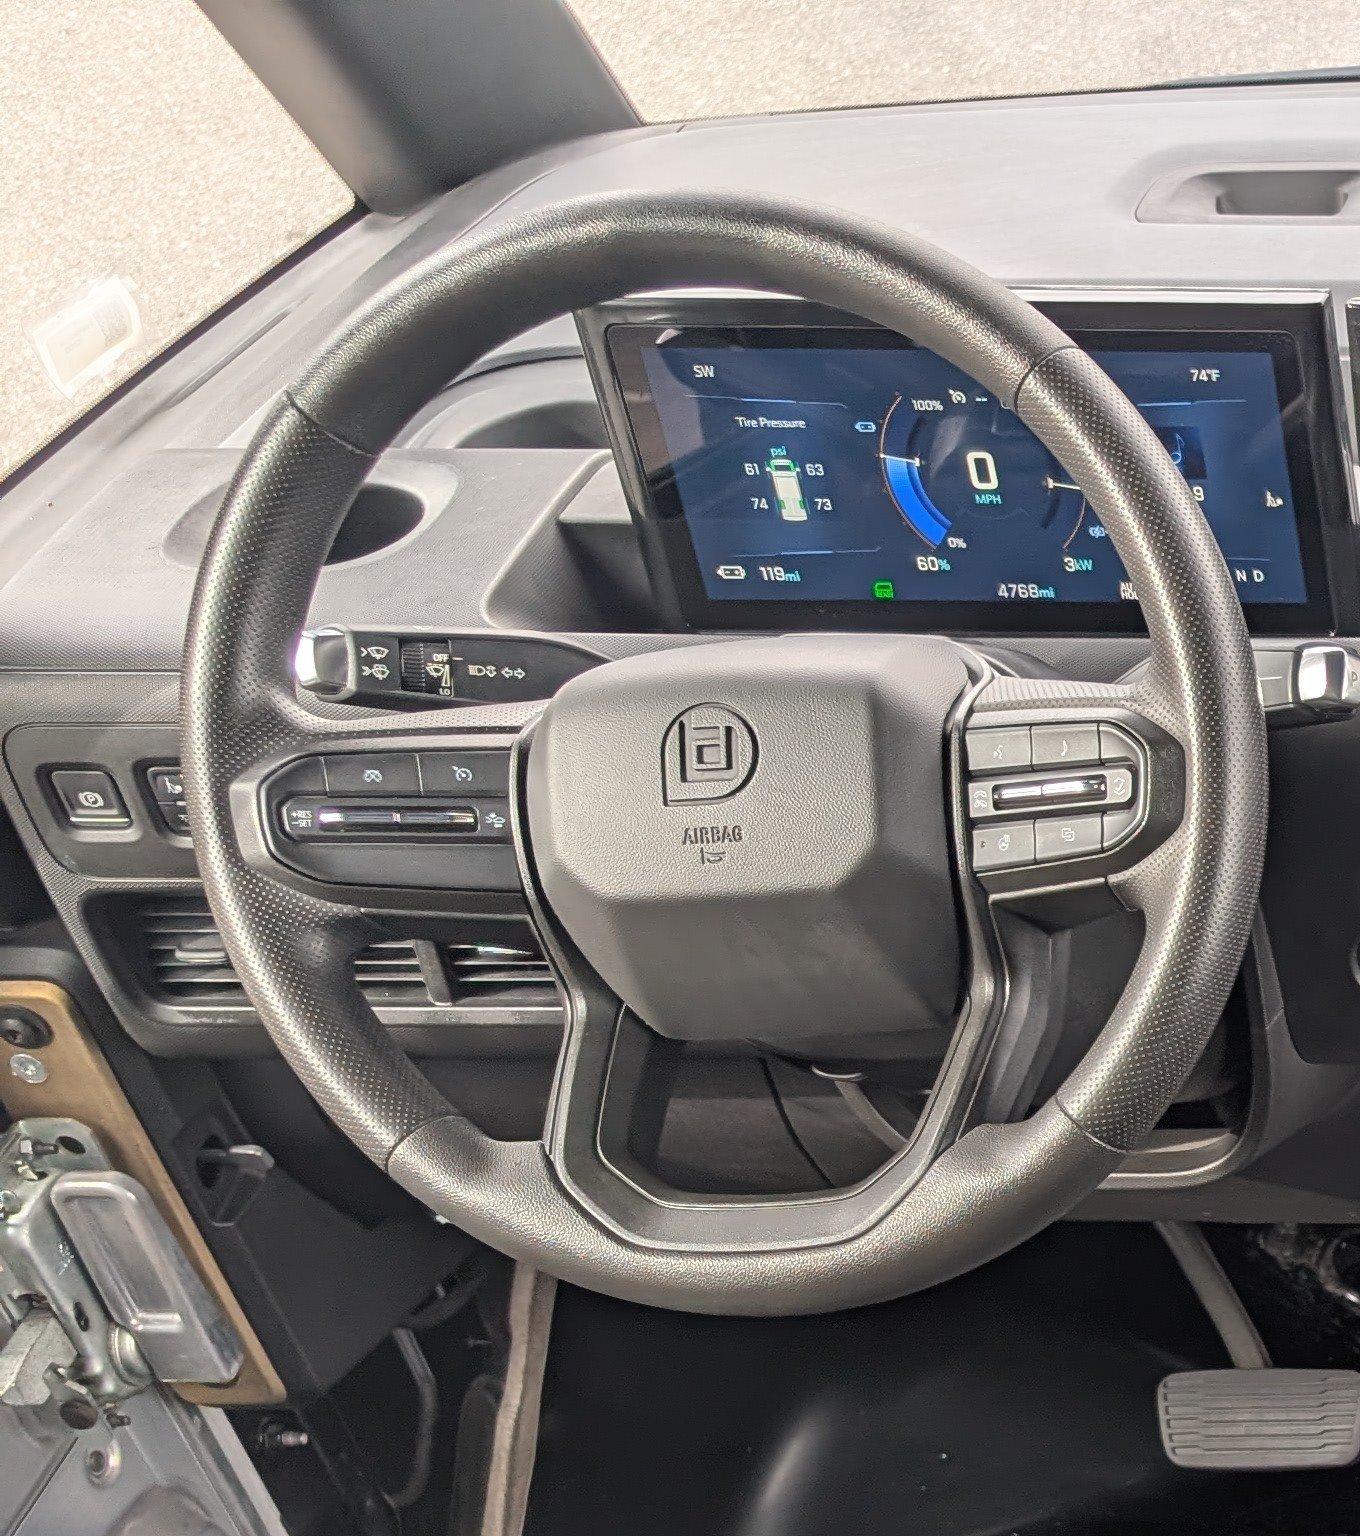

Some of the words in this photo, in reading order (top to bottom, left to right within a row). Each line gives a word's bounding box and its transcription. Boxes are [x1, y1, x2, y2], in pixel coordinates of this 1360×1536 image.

[693, 365, 715, 378] SW
[912, 400, 944, 411] 100%
[734, 416, 758, 428] Tire
[758, 416, 806, 429] Pressure
[770, 446, 787, 457] psi
[744, 463, 760, 476] 61
[805, 463, 825, 476] 63
[966, 452, 998, 490] 0
[751, 498, 769, 510] 74
[814, 498, 833, 511] 73
[975, 494, 1001, 505] MPH
[947, 537, 967, 549] 0%
[433, 653, 450, 662] OFF
[439, 687, 451, 695] LO
[682, 825, 743, 845] AIRBAG
